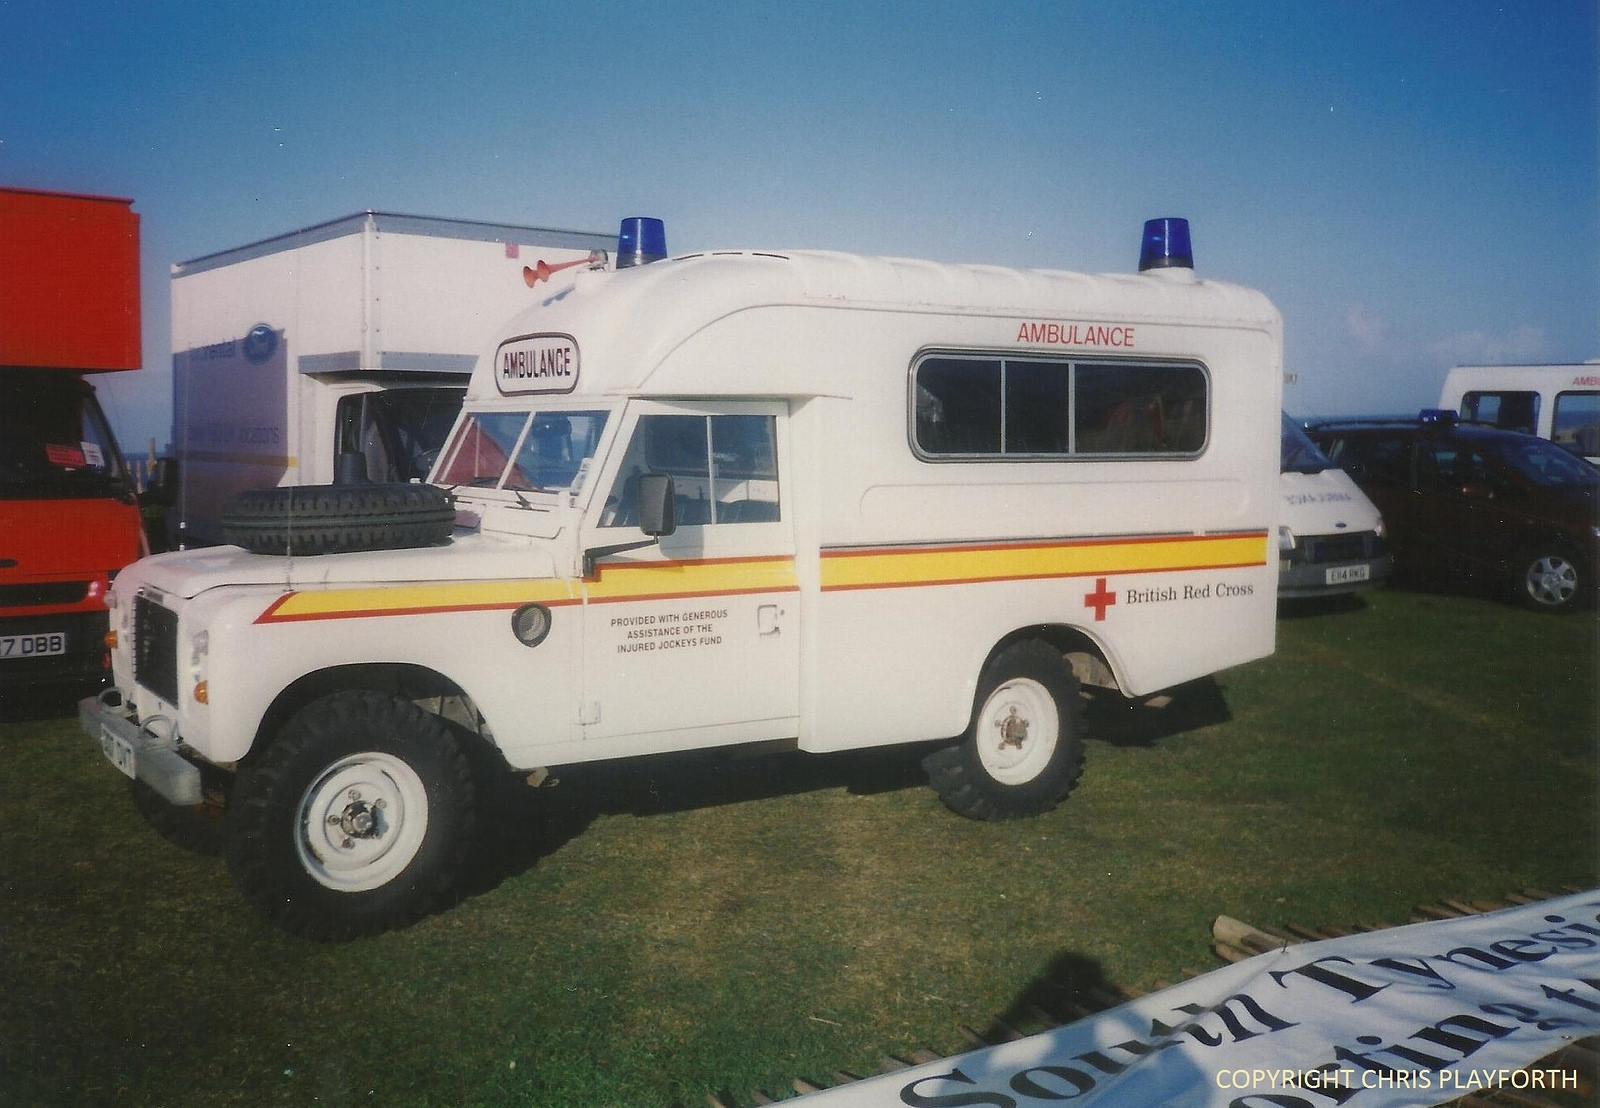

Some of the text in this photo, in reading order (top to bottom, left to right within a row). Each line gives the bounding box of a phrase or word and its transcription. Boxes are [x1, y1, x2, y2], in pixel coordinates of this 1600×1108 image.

[1017, 322, 1135, 347] AMBULANCE
[502, 347, 571, 379] AMBULANCE
[1126, 582, 1254, 605] British Red Cross
[611, 609, 729, 627] PROVIDED WITH GENEROUS
[627, 623, 713, 640] ASSISTANCE OF THE
[0, 635, 62, 656] 7 DBB
[617, 635, 723, 654] INJURED JOCKEYS FUND
[1268, 902, 1600, 1003] Tynesi
